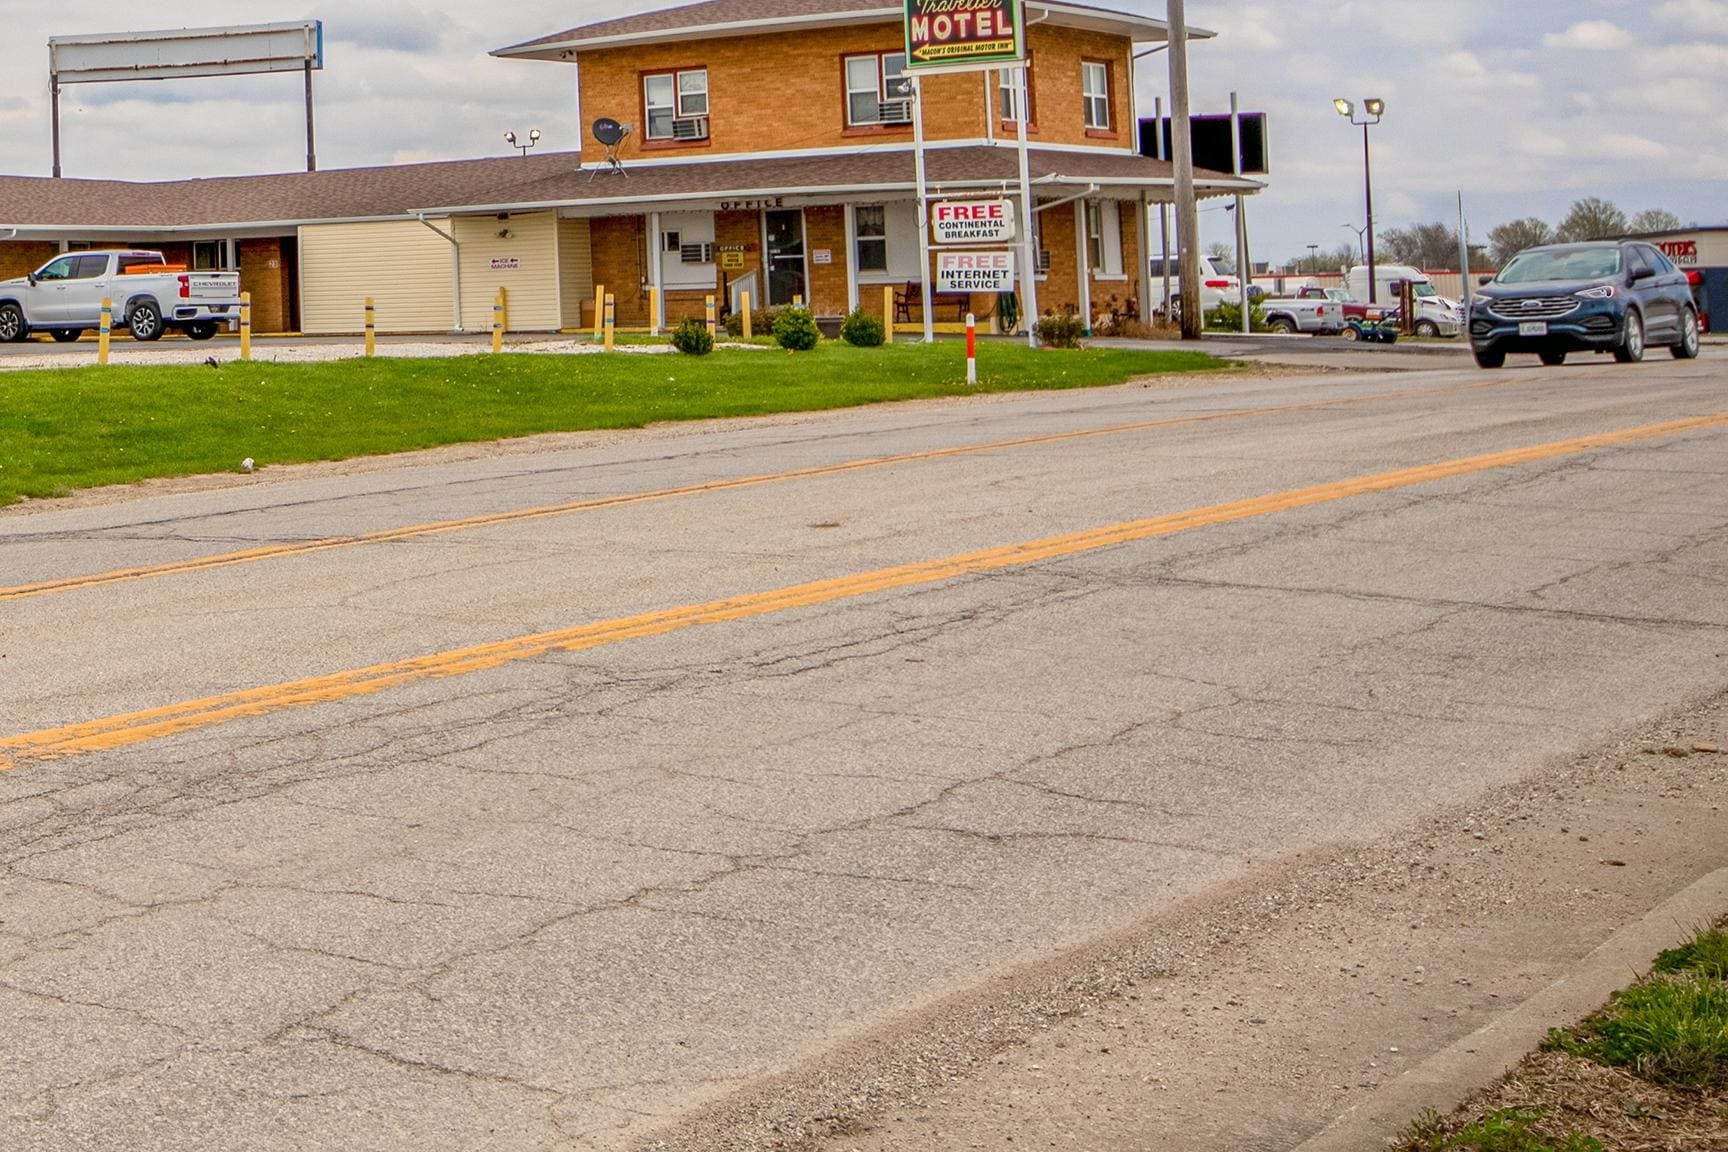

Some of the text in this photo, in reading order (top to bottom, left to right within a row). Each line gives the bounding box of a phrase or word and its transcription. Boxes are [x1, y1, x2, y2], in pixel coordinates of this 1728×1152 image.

[911, 10, 1013, 41] MOTEL
[947, 44, 974, 54] ORIGINAL
[975, 42, 996, 52] MOTOR
[720, 198, 783, 209] OFFICE
[938, 204, 1003, 221] FREE
[938, 220, 1005, 230] CONTINENTAL
[944, 229, 1000, 239] BREAKFAST
[942, 255, 1008, 269] FREE
[941, 269, 1009, 279] INTERNET
[950, 279, 1000, 289] SERVICE
